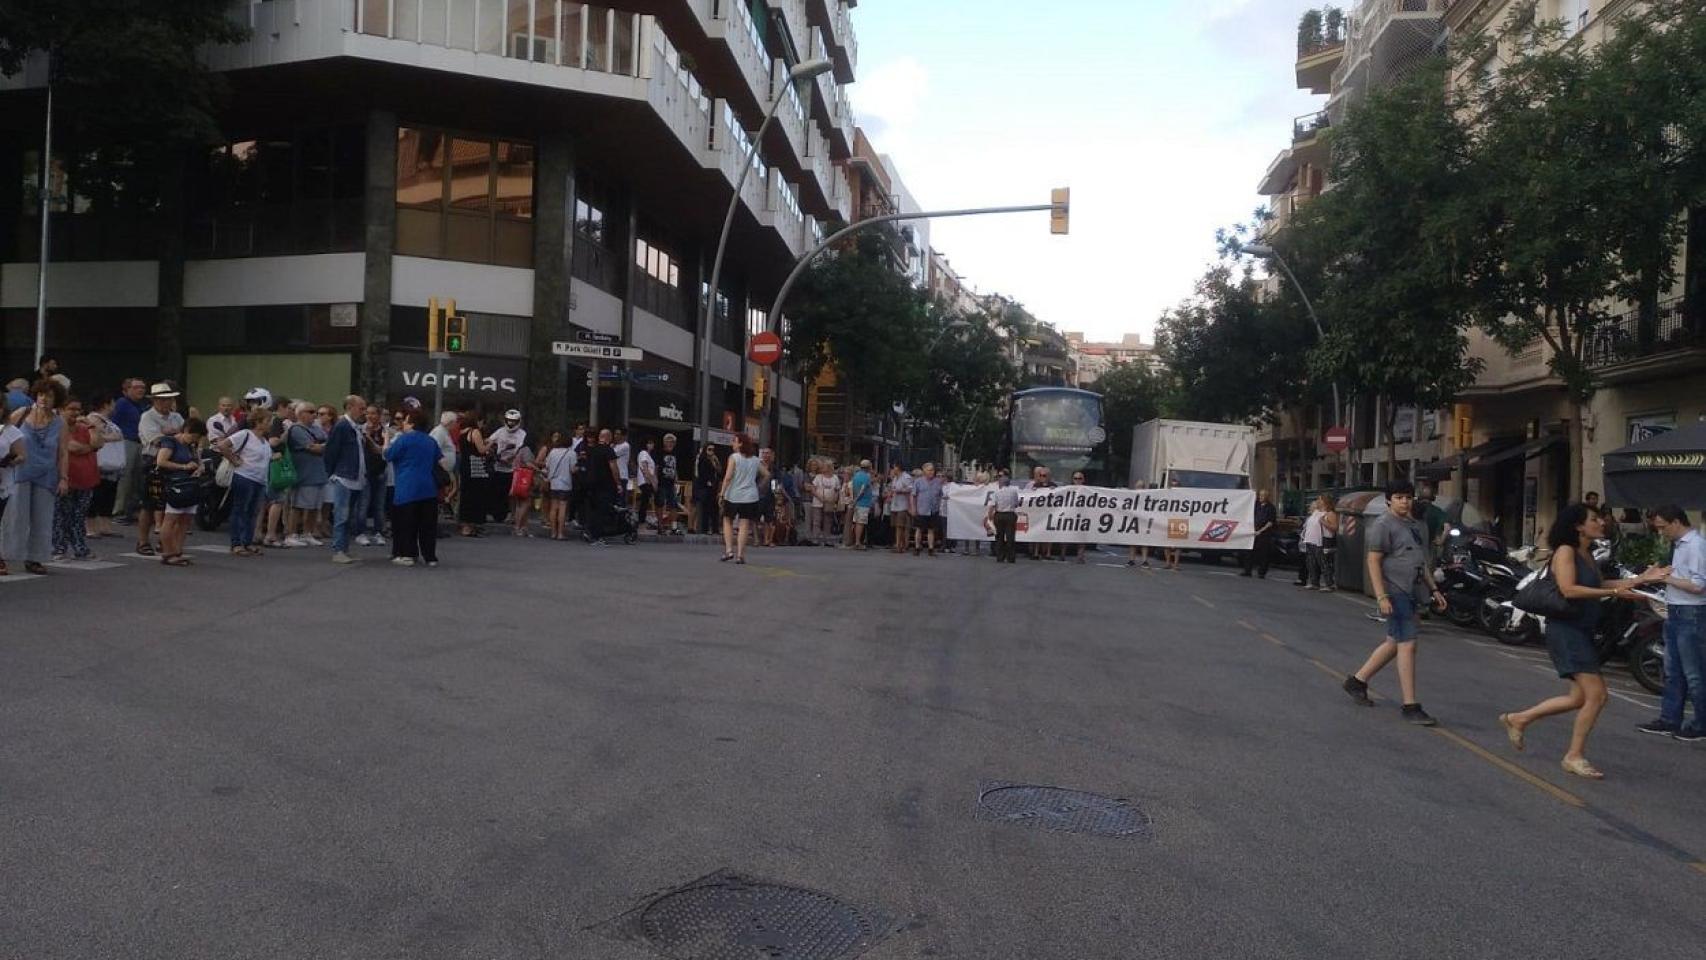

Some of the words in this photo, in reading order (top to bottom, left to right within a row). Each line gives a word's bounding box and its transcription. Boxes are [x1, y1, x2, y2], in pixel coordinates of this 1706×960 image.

[565, 344, 581, 352] Park
[402, 367, 516, 393] veritas
[1028, 491, 1117, 509] retallades
[1122, 494, 1140, 511] al
[1144, 495, 1229, 516] transport
[1046, 512, 1091, 531] Línia
[1097, 513, 1114, 533] 9
[1117, 515, 1139, 534] JA
